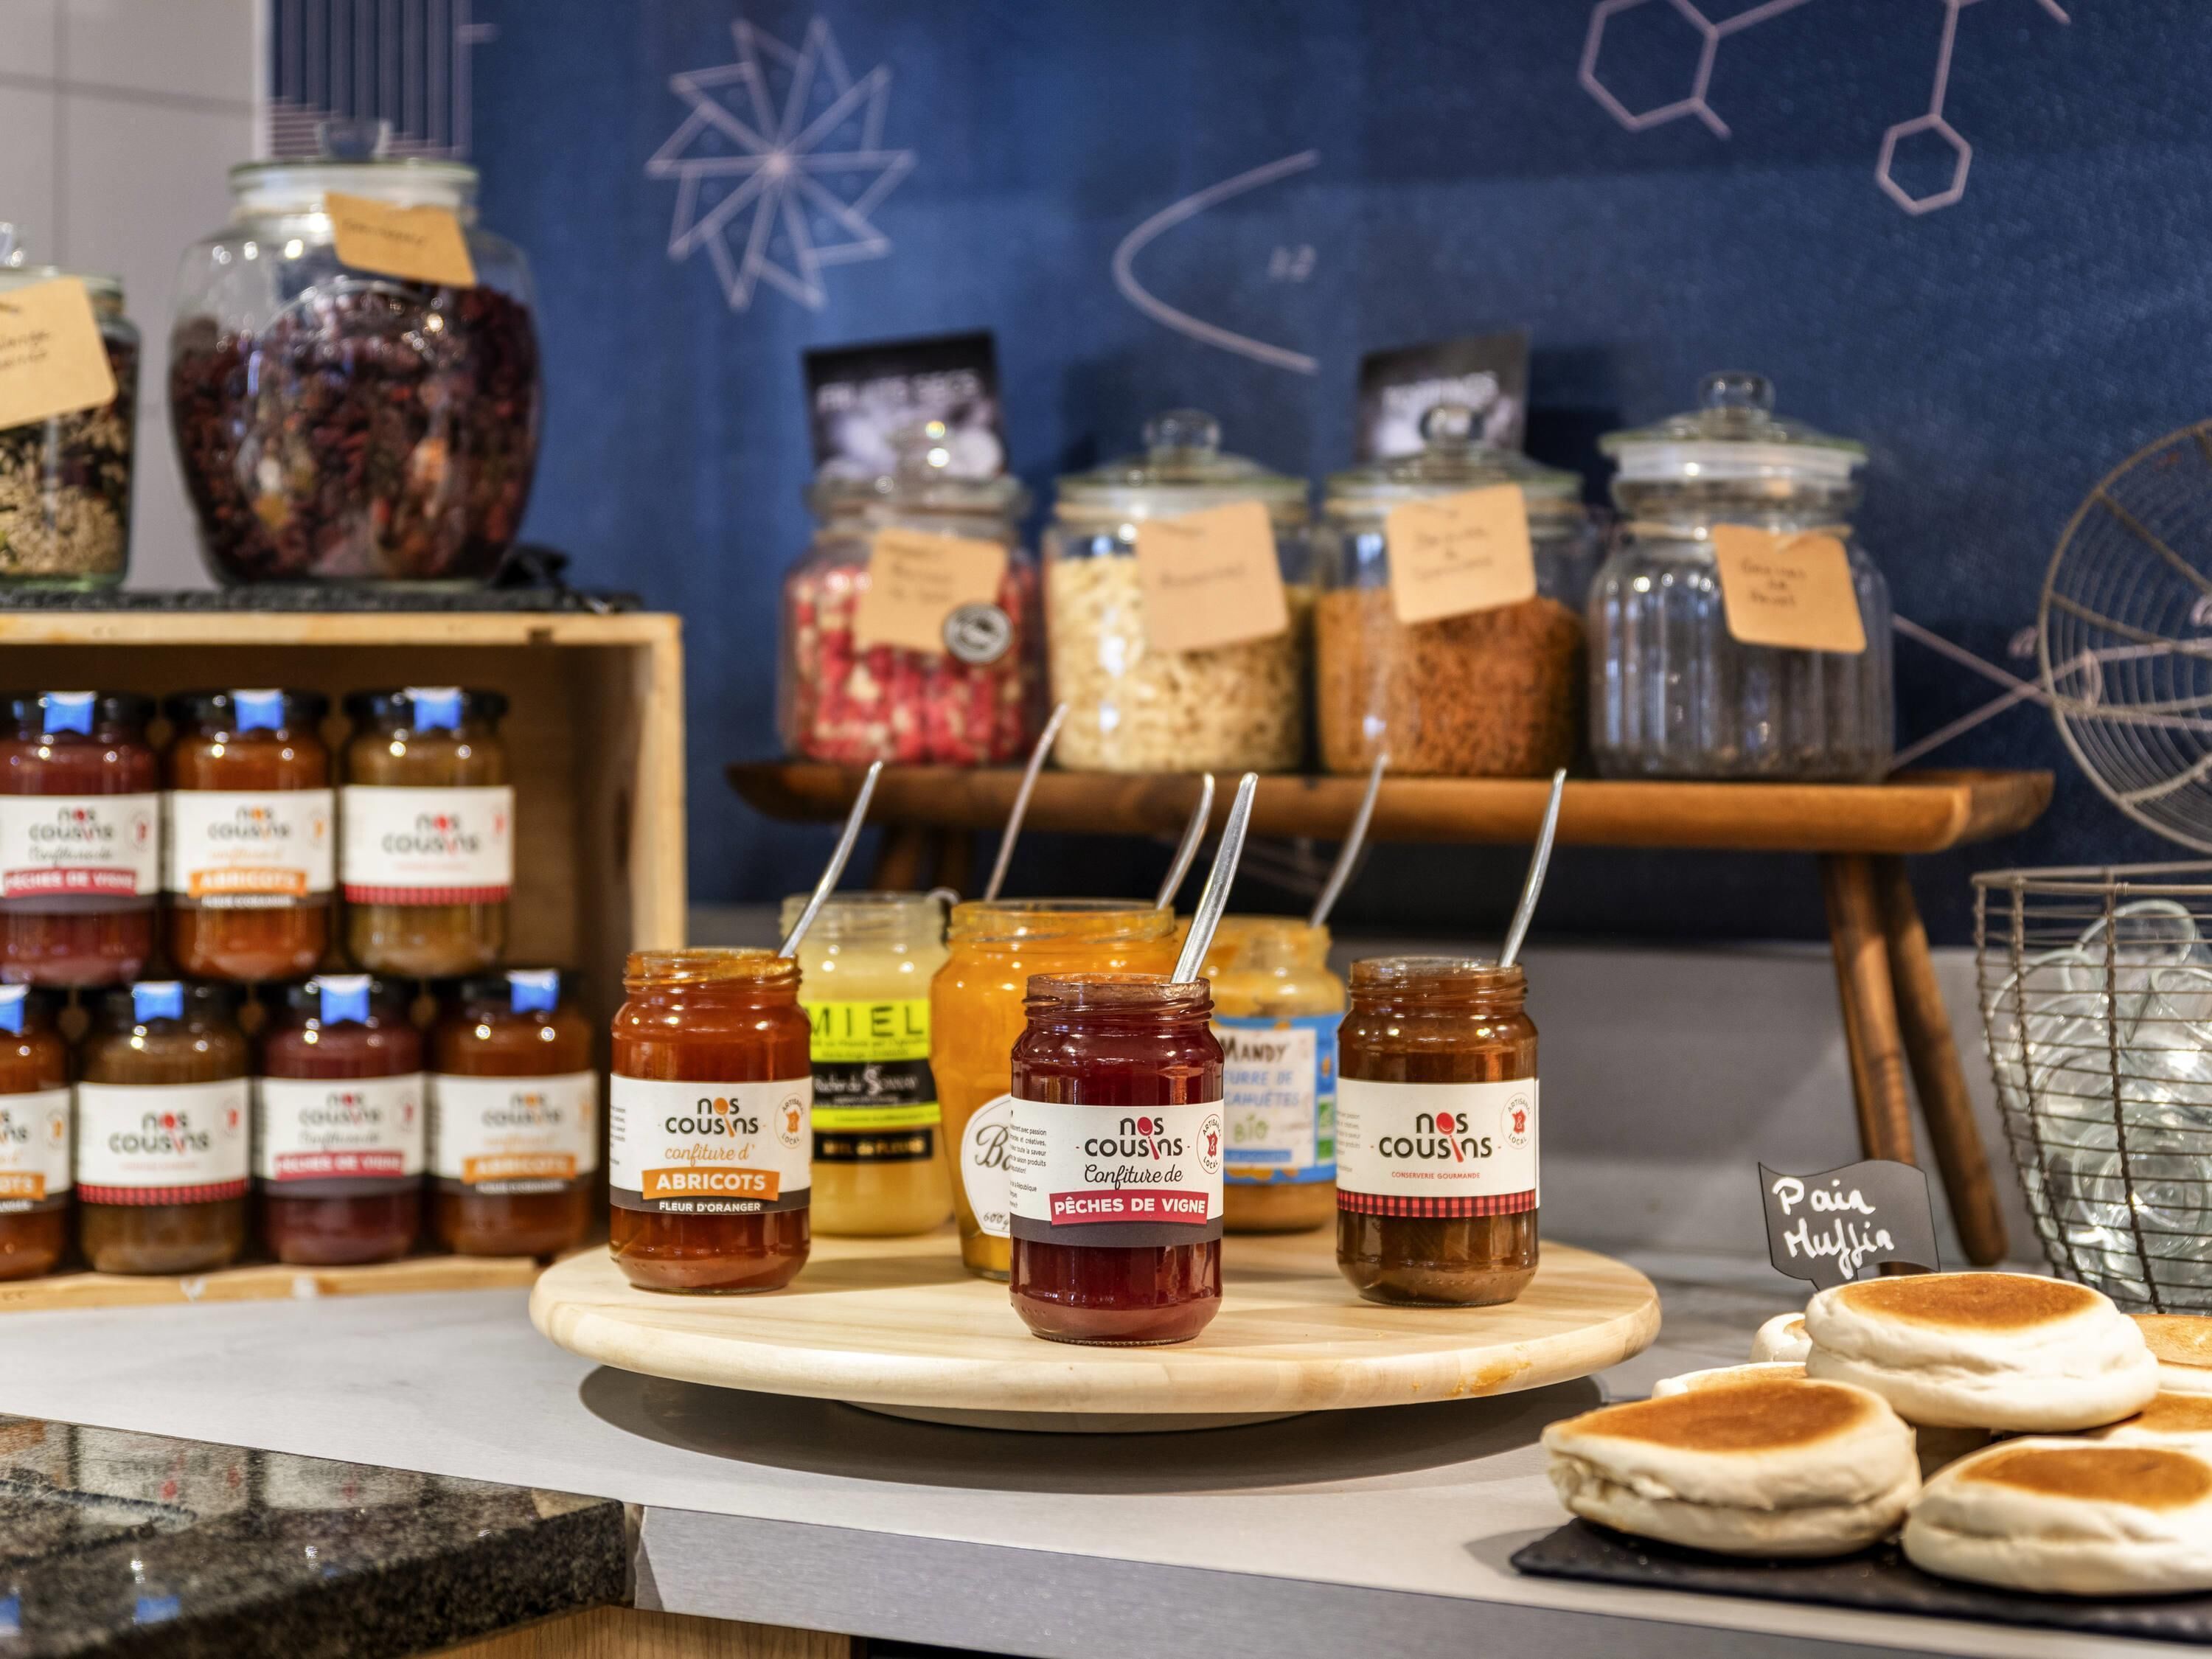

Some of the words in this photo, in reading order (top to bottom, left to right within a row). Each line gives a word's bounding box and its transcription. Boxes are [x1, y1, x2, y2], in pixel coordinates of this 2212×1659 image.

[806, 1005, 924, 1037] MIEL
[697, 1096, 740, 1116] nos
[665, 1116, 759, 1138] cousins
[1029, 1127, 1047, 1136] passion
[1119, 1116, 1164, 1136] nos
[1415, 1111, 1470, 1135] nos
[1508, 1133, 1528, 1145] LOCAL
[665, 1143, 737, 1166] confiture
[1031, 1149, 1046, 1157] saveur
[1084, 1138, 1183, 1161] cousins
[1379, 1136, 1493, 1163] cousins
[1027, 1158, 1047, 1167] produits
[1203, 1155, 1218, 1169] LOCAL
[655, 1172, 766, 1192] ABRICOTS
[1084, 1164, 1163, 1191] Confiture
[1164, 1164, 1183, 1182] de
[1391, 1171, 1435, 1180] CONSERVERIE
[1437, 1172, 1481, 1180] GOURMANDE
[1054, 1196, 1124, 1215] PÊCHES
[1130, 1198, 1155, 1212] DE
[1161, 1198, 1206, 1214] VIGNE
[1772, 1177, 1877, 1216] Pain
[658, 1201, 693, 1213] FLEUR
[696, 1202, 762, 1213] D'ORANGER
[1783, 1217, 1895, 1281] Muffin
